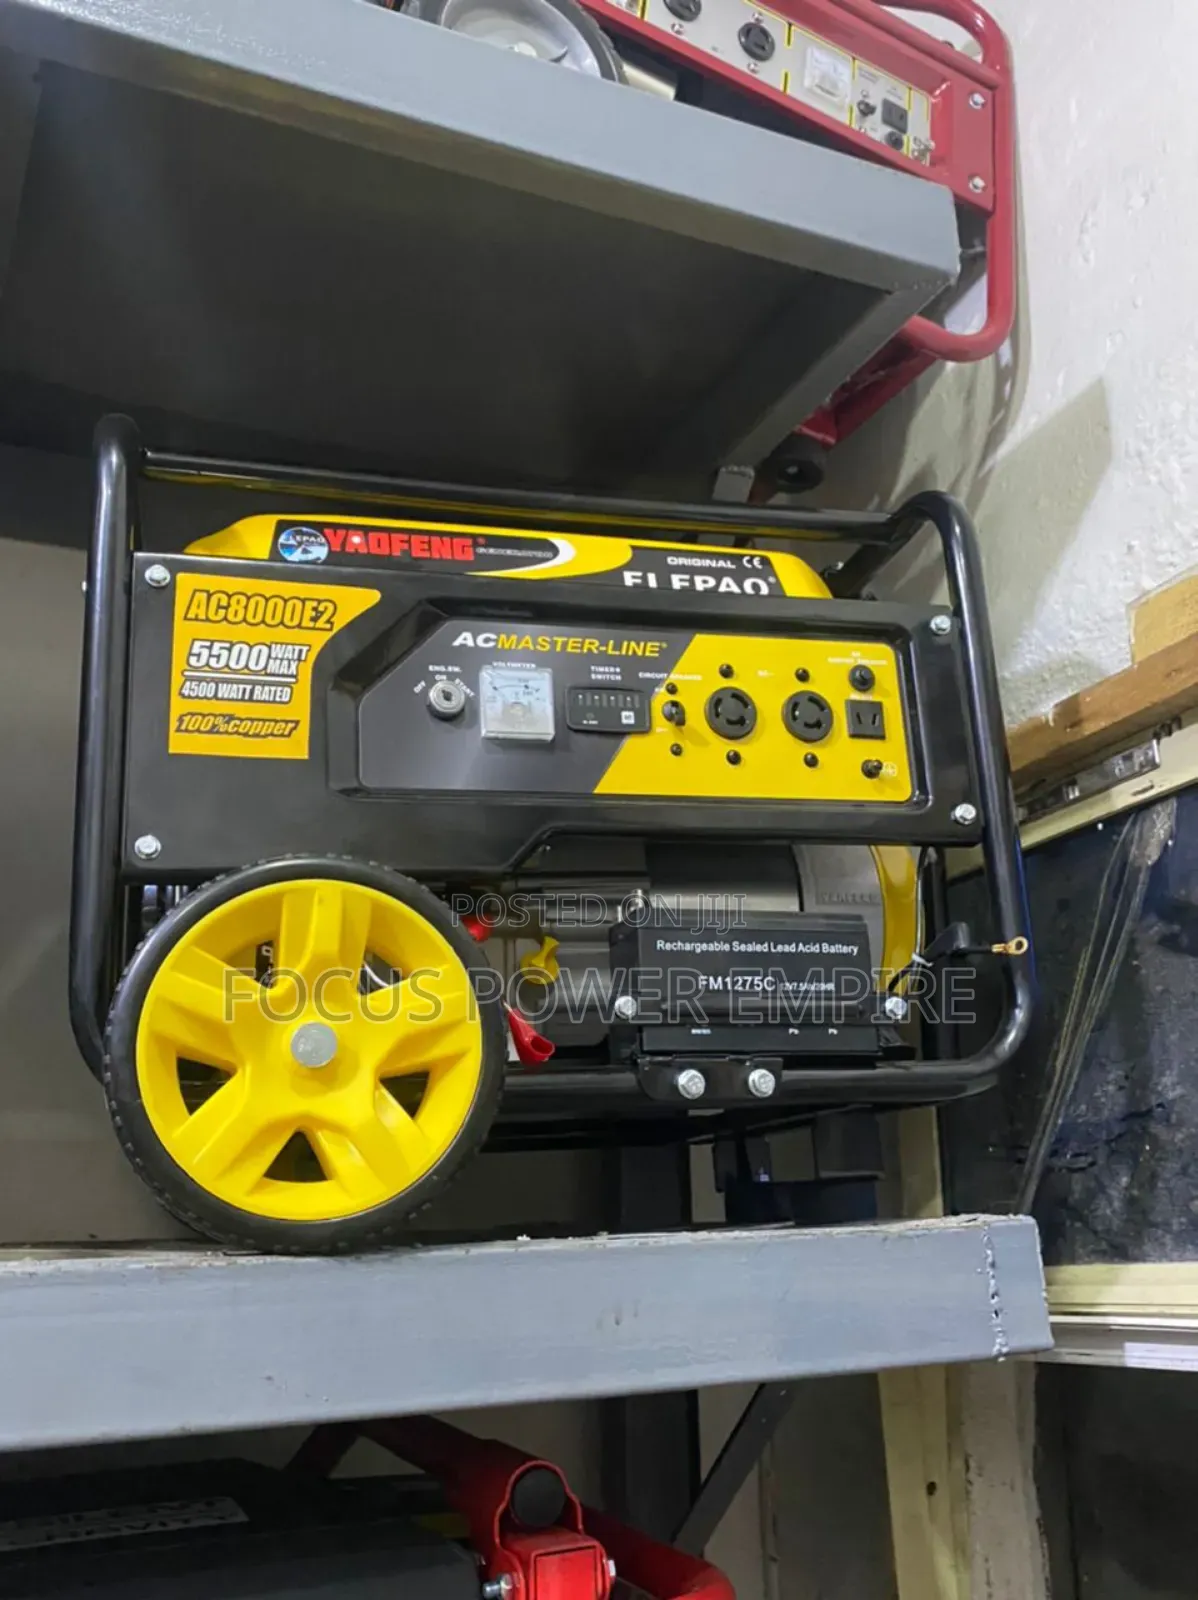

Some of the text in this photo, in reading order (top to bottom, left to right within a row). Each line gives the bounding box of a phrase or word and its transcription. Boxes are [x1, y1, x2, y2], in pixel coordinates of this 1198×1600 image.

[322, 528, 475, 561] YAOFENG
[666, 556, 736, 569] ORIGINAL
[184, 589, 337, 631] AC8000E2
[188, 640, 309, 672] 5500 WATT
[266, 659, 298, 676] MAX
[638, 671, 668, 680] CIRCUIT
[591, 673, 622, 681] SWITCH
[181, 681, 291, 703] 4500 WATT RATED
[656, 939, 859, 956] Rechargeable Sealed Lead Acid Battery
[698, 975, 776, 991] FM1275C
